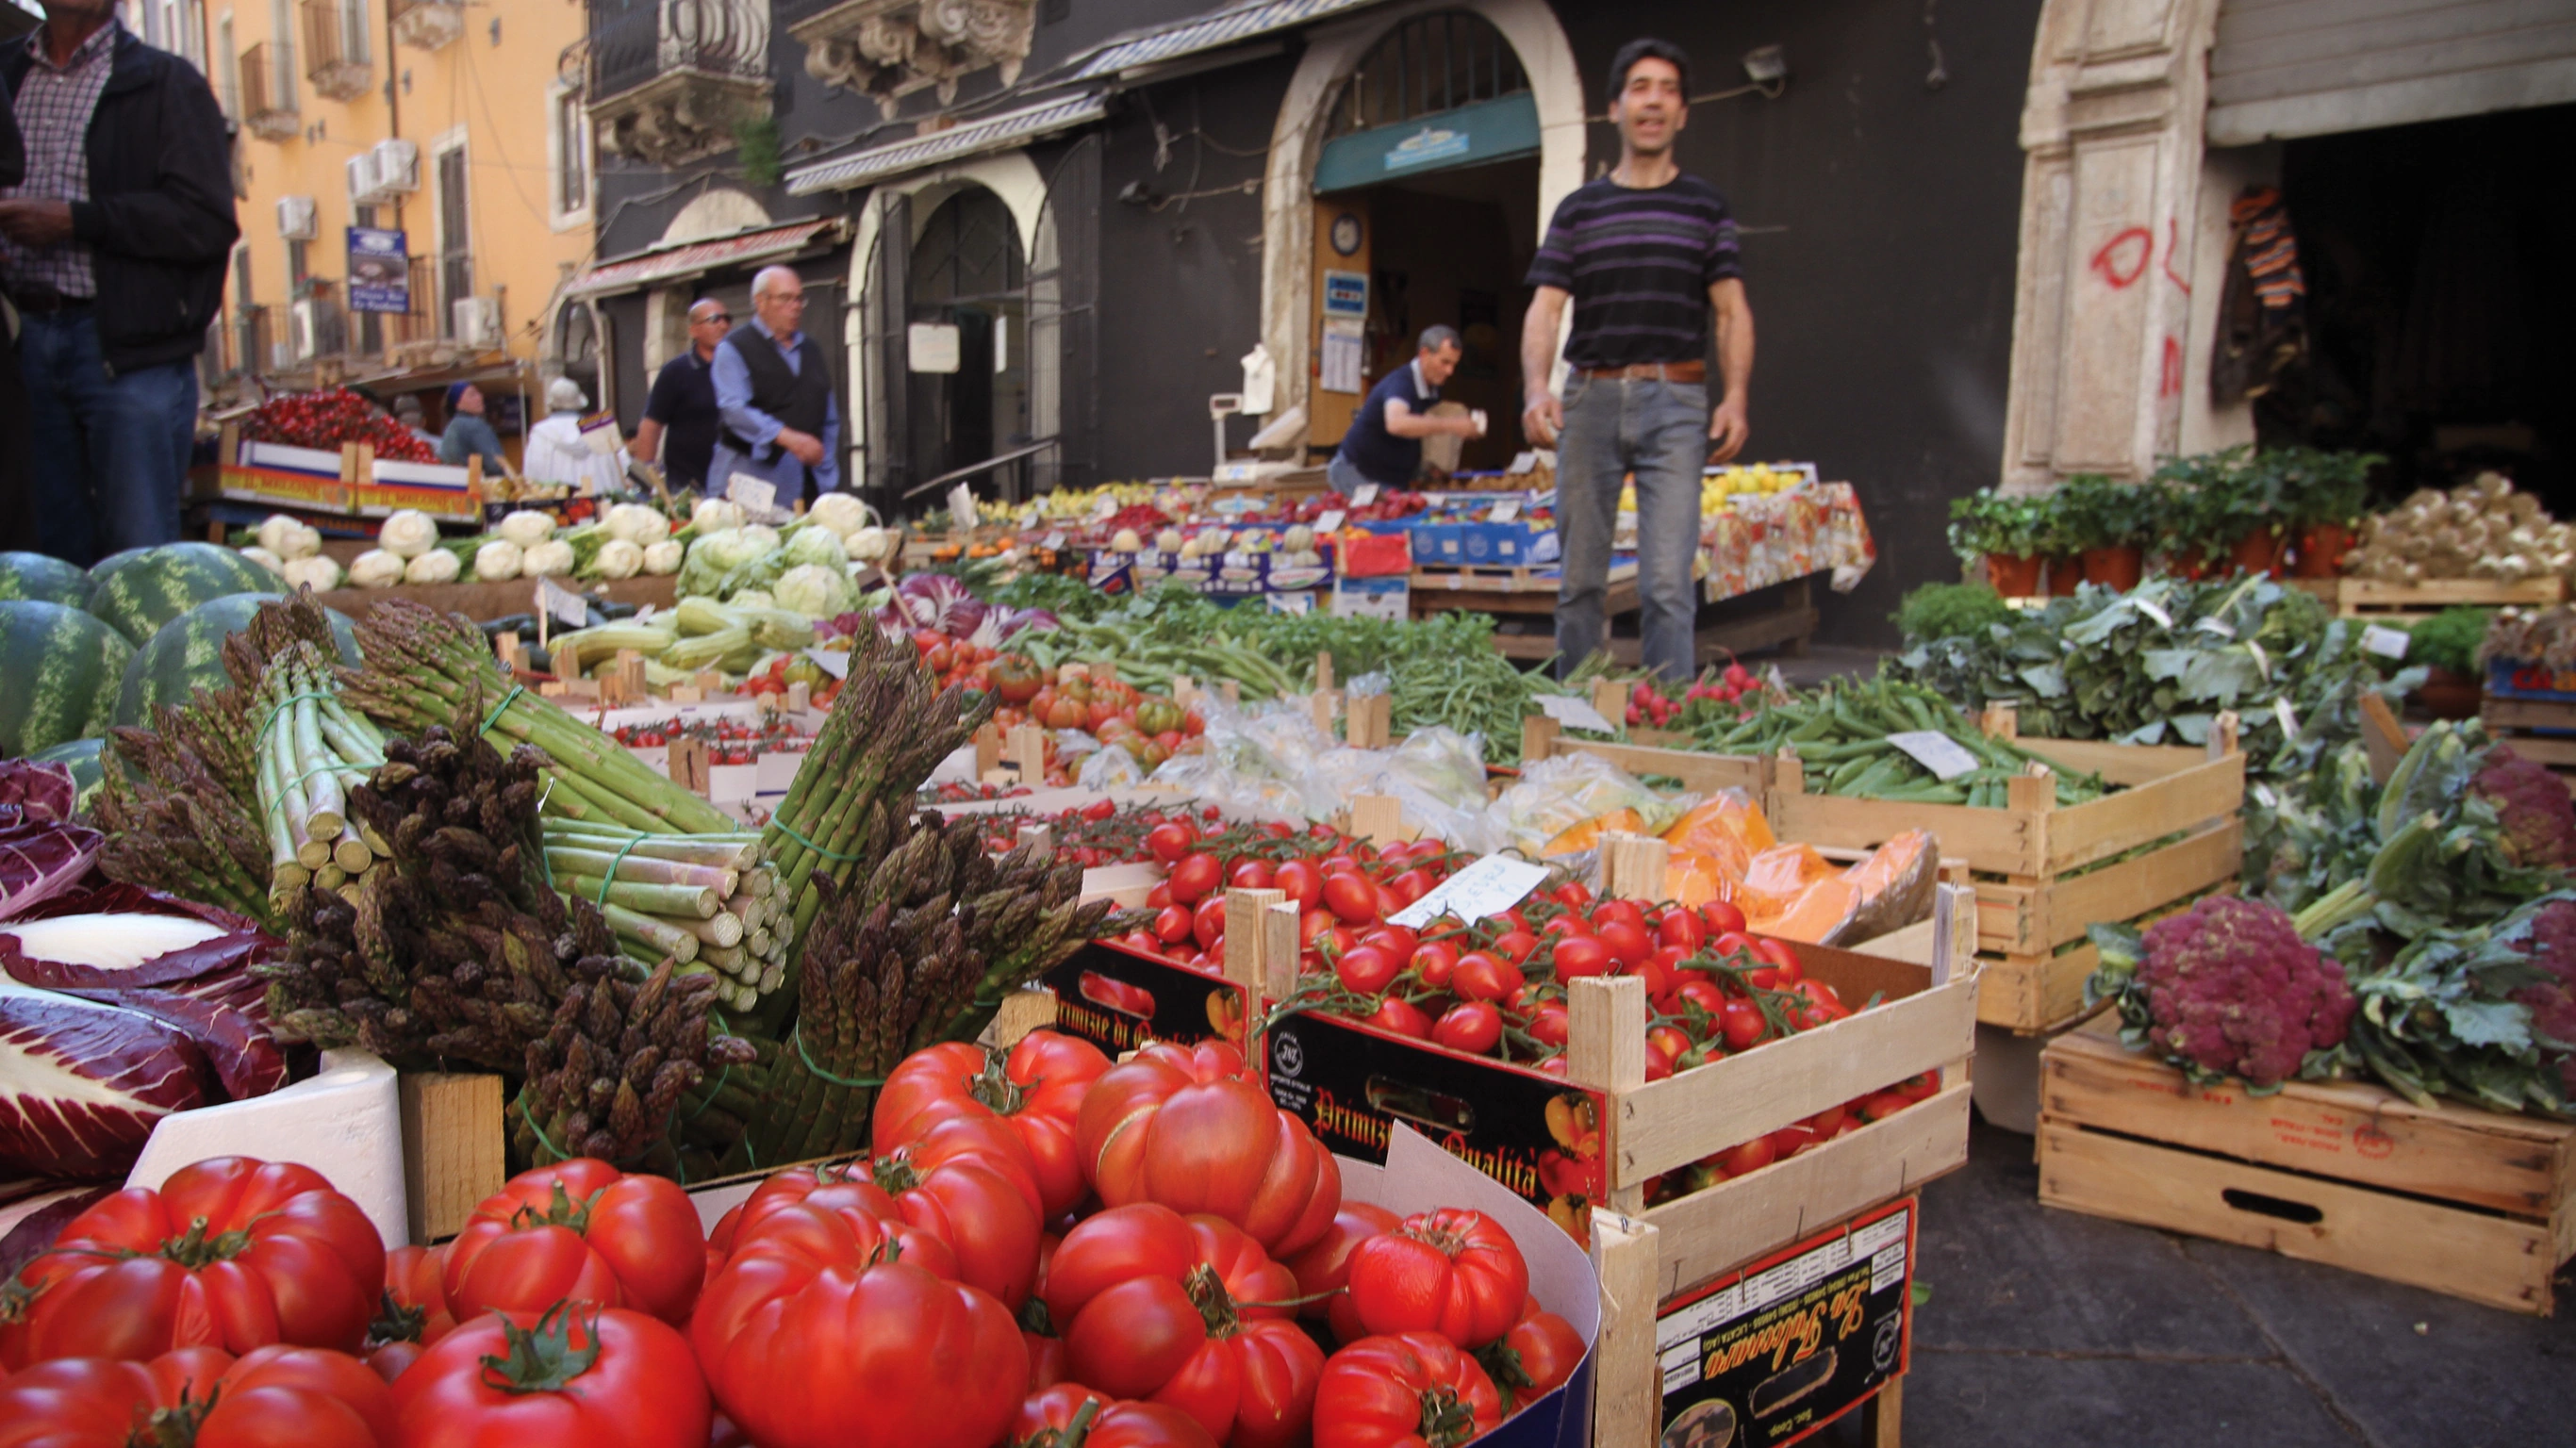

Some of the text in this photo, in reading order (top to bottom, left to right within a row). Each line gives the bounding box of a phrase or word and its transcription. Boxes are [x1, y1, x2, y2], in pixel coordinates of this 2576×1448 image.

[1113, 1012, 1129, 1049] di
[1313, 1085, 1395, 1160] Primizi
[1830, 1279, 1871, 1341] La
[1703, 1336, 1721, 1353] (AG)
[1704, 1300, 1827, 1380] Falconara
[1721, 1321, 1748, 1344] LICATA
[1768, 1407, 1812, 1438] Soc. Coop.
